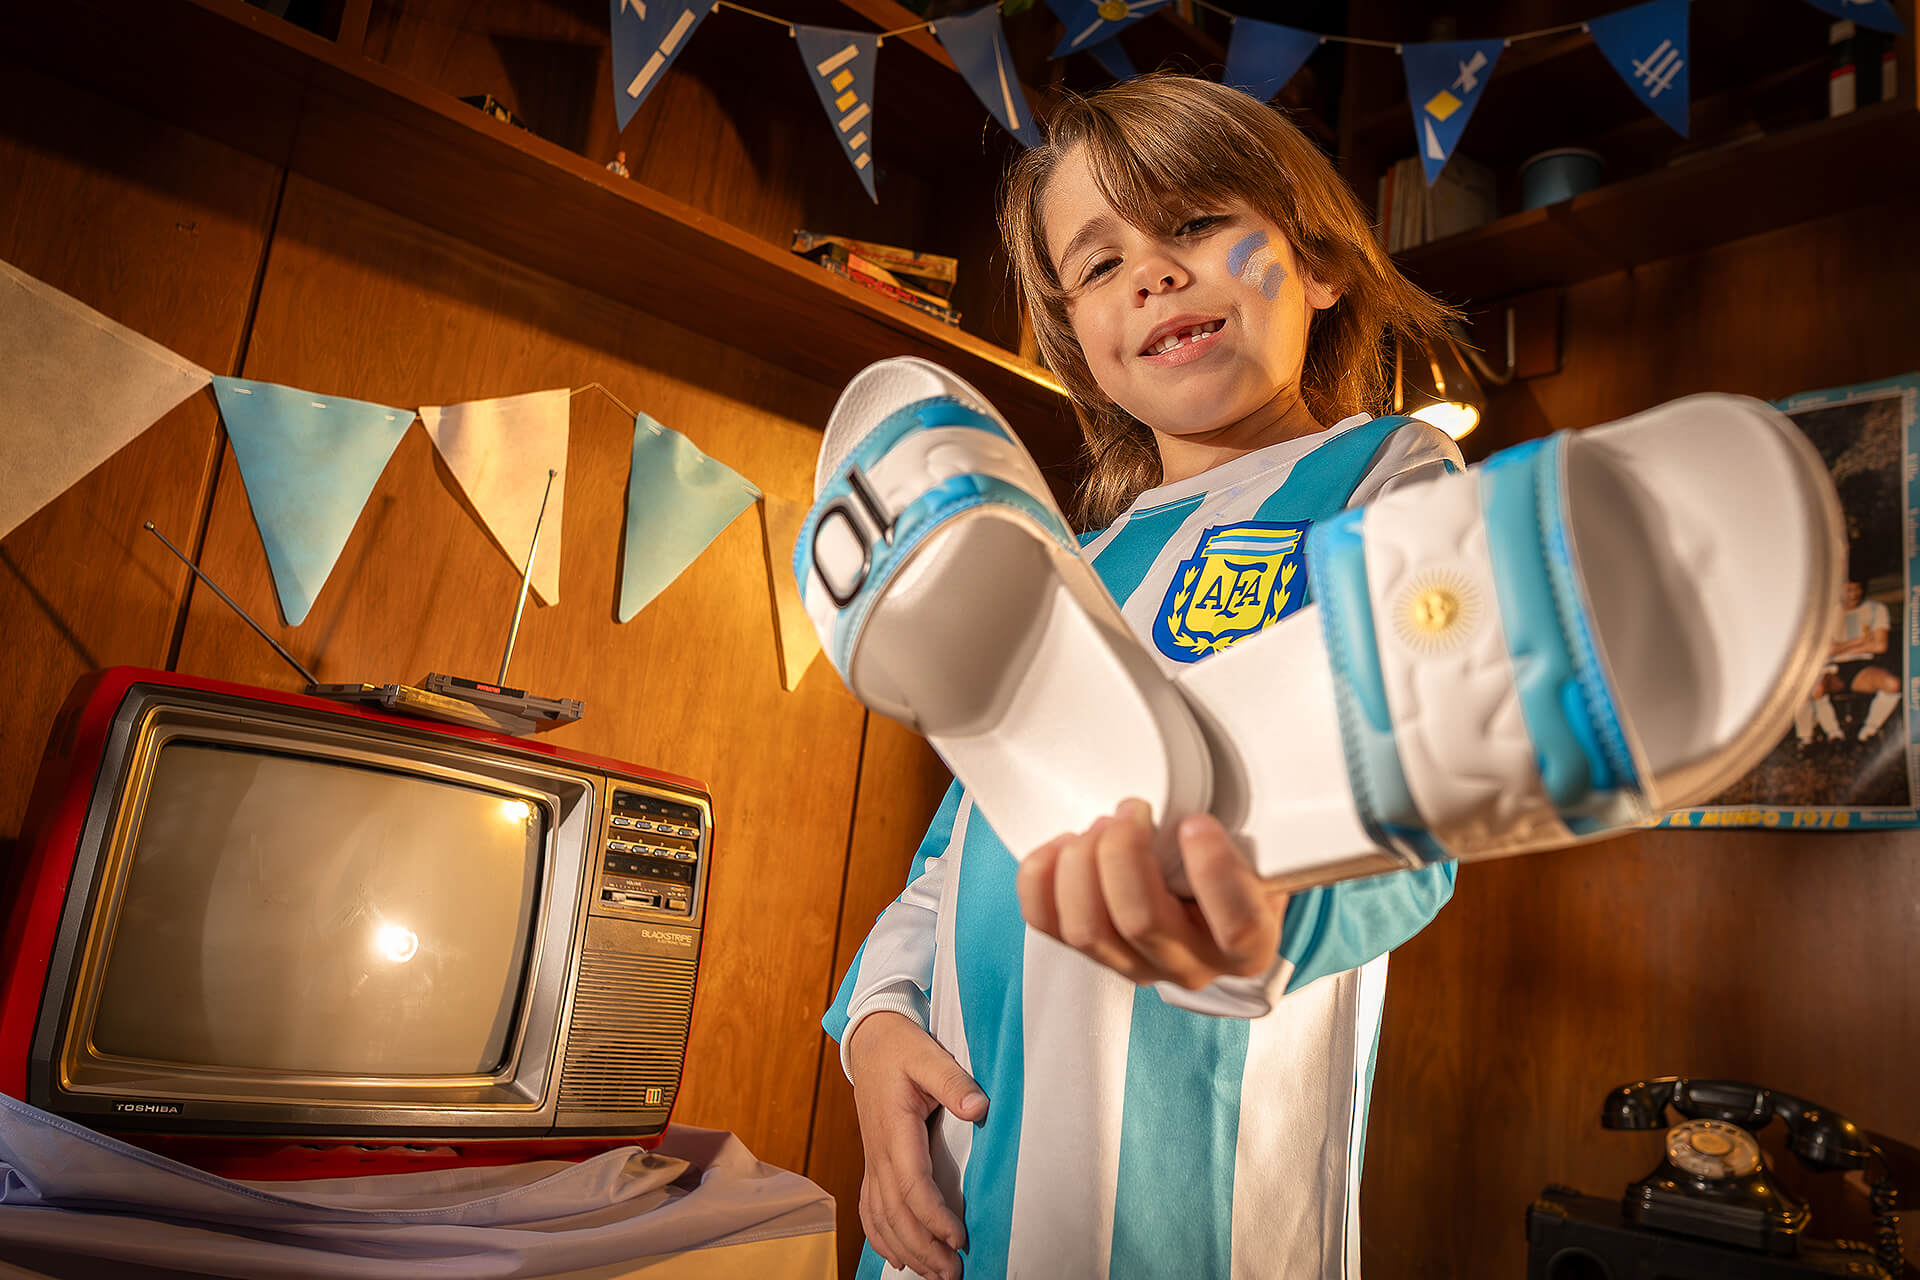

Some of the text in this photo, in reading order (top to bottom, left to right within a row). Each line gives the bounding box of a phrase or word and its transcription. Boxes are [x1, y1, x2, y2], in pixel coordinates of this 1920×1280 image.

[1195, 559, 1268, 619] AFA
[1669, 811, 1690, 825] EL
[1701, 809, 1781, 826] MUNDO
[1792, 811, 1850, 828] 1978
[641, 929, 692, 943] BLACKSTRIPE
[116, 1104, 178, 1113] TOSHIBA
